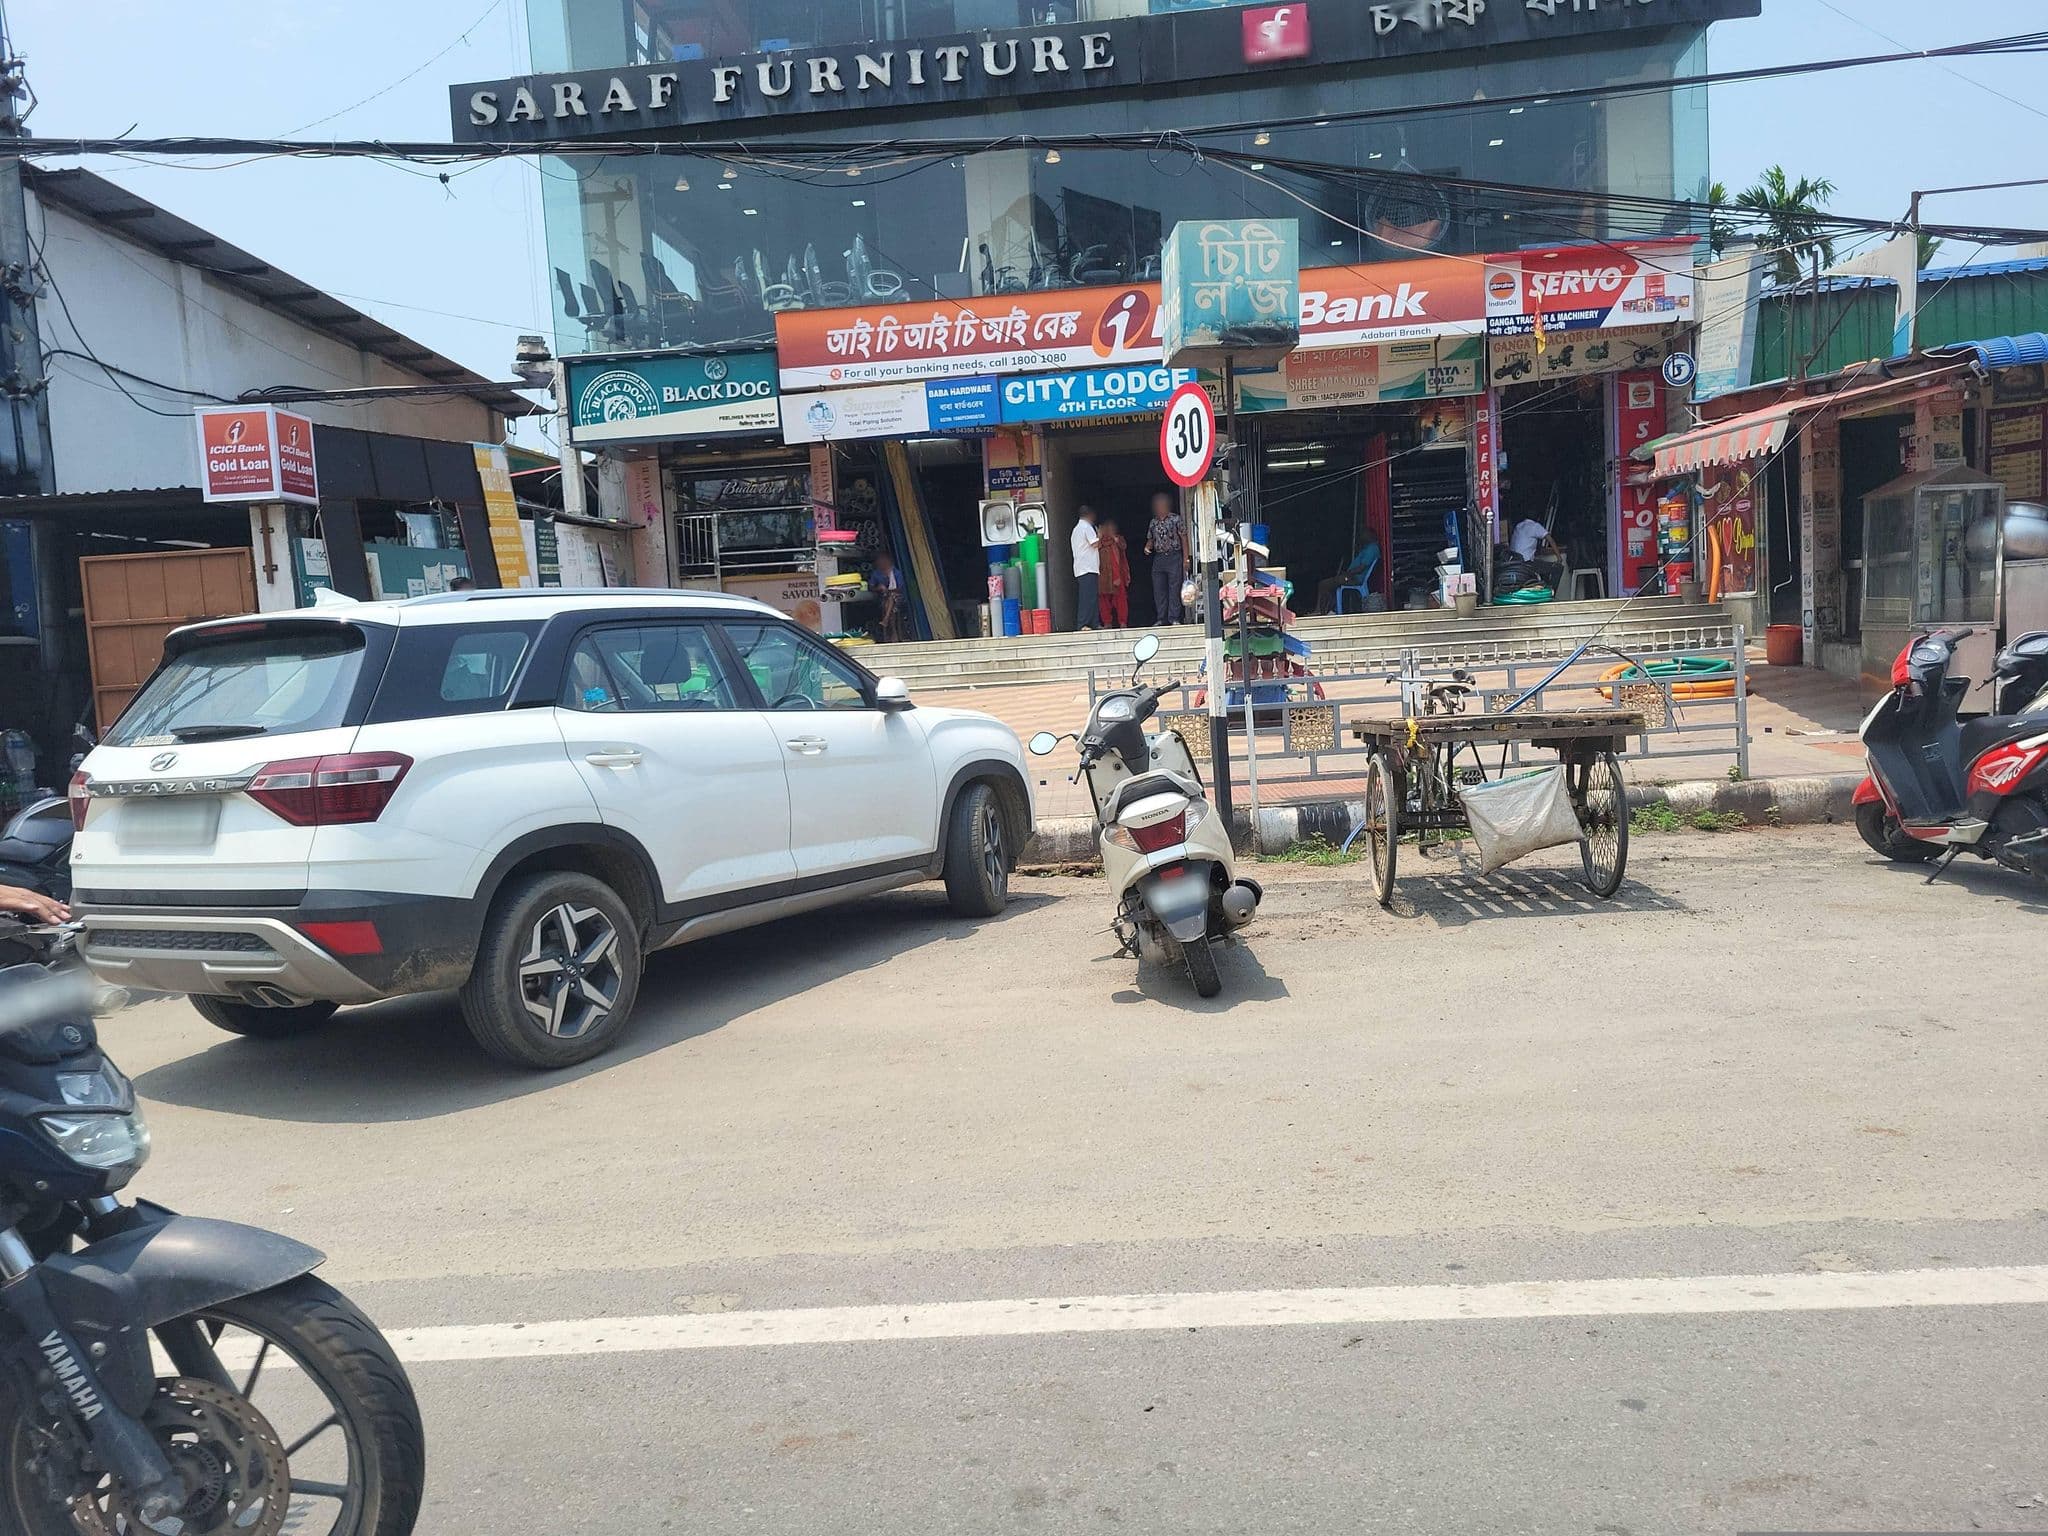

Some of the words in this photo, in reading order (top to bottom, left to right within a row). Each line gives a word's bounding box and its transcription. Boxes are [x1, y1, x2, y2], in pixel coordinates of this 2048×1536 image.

[469, 72, 679, 126] SARAF
[710, 31, 1115, 103] FURNITURE
[1528, 266, 1624, 298] SERVO
[1299, 282, 1429, 326] Bank
[1489, 317, 1515, 327] GANGA
[1516, 313, 1549, 325] TRACR
[1550, 313, 1557, 322] &
[1558, 309, 1600, 321] MACHINERY
[826, 318, 875, 359] আই
[903, 311, 952, 354] আই
[981, 304, 1031, 348] আই
[1360, 329, 1398, 341] Adabari
[1399, 326, 1432, 338] Branch
[1493, 340, 1531, 354] GANGA
[844, 367, 862, 378] For
[864, 366, 878, 377] all
[879, 366, 904, 381] your
[906, 360, 949, 376] banking
[951, 358, 987, 371] needs,
[989, 356, 1008, 368] call
[1011, 354, 1037, 366] 1800
[1040, 352, 1067, 364] 1080
[1427, 366, 1460, 377] TATA
[662, 384, 725, 403] BLACK
[725, 380, 771, 399] DOG
[928, 389, 949, 398] BABA
[950, 384, 993, 396] HARDWARE
[1004, 376, 1077, 405] CITY
[1086, 367, 1189, 398] LODGE
[1289, 377, 1317, 393] SHREE
[590, 381, 622, 409] BLACK
[622, 382, 646, 404] DOG
[1058, 401, 1086, 413] 4TH
[1089, 396, 1137, 410] FLOOR
[1069, 414, 1130, 428] COMMERCIAL
[1173, 406, 1204, 459] 30
[209, 444, 237, 455] ICICI
[237, 443, 265, 453] Bank
[280, 443, 296, 455] ICICI
[295, 447, 311, 459] Bank
[209, 459, 238, 473] Gold
[239, 458, 270, 470] Loan
[280, 457, 297, 473] Gold
[296, 460, 314, 476] Loan
[991, 477, 1011, 485] CITY
[1012, 475, 1041, 483] LODGE
[782, 589, 820, 600] SAVOU
[103, 779, 217, 796] ALCAZAR
[1140, 808, 1169, 821] HONDA
[38, 1329, 105, 1422] YAMAHA
